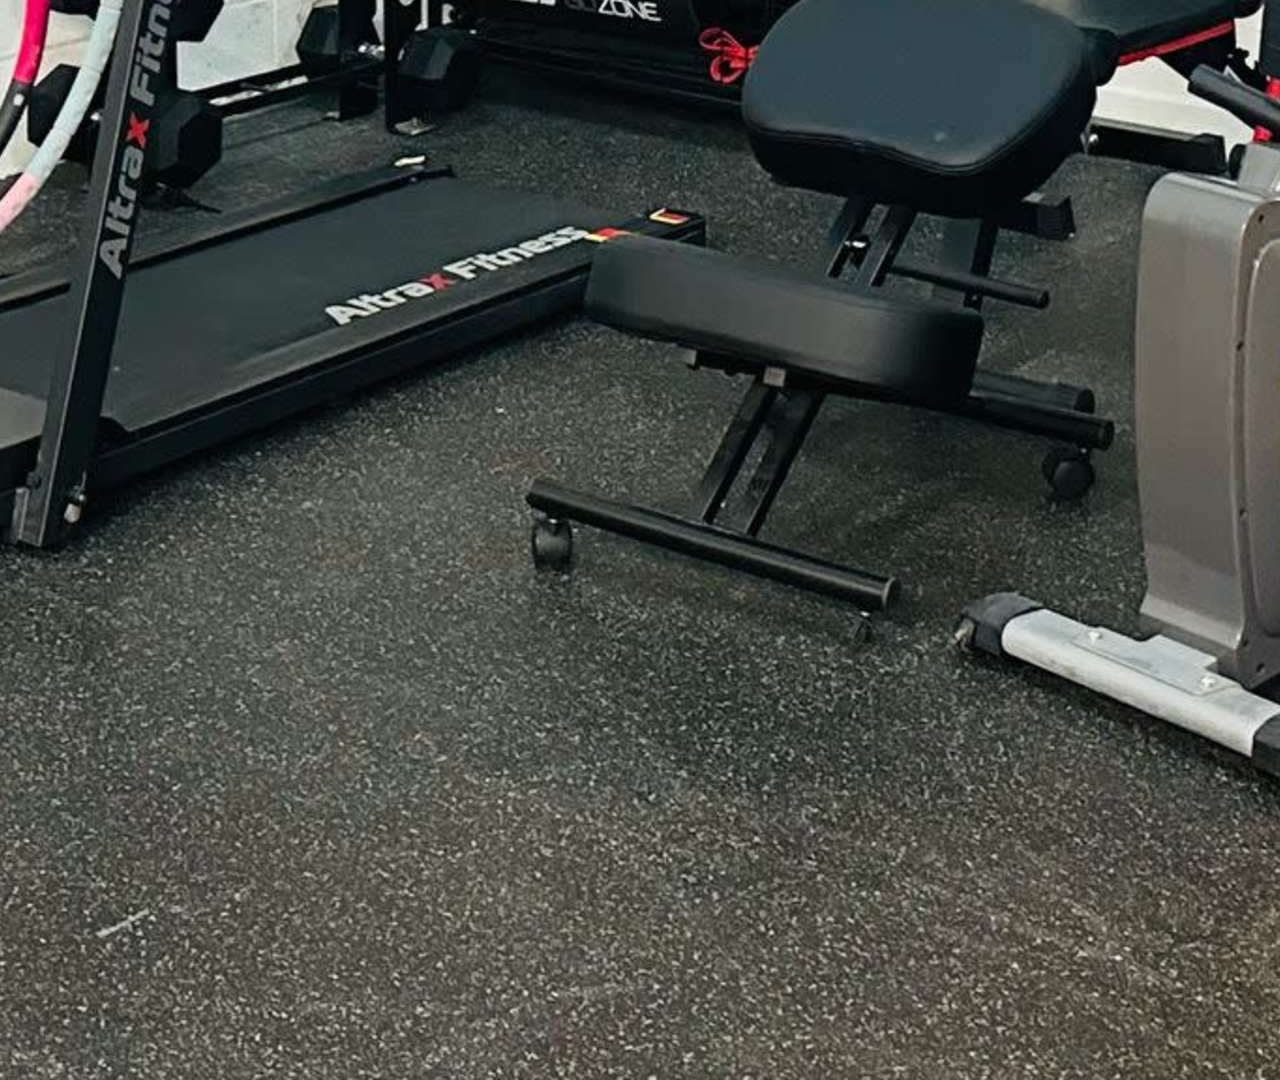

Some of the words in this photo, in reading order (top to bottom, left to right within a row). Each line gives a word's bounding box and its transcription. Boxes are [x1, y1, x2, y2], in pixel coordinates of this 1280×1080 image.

[99, 112, 149, 280] Altrax
[324, 272, 456, 326] Altrax
[442, 226, 590, 280] Fitness
